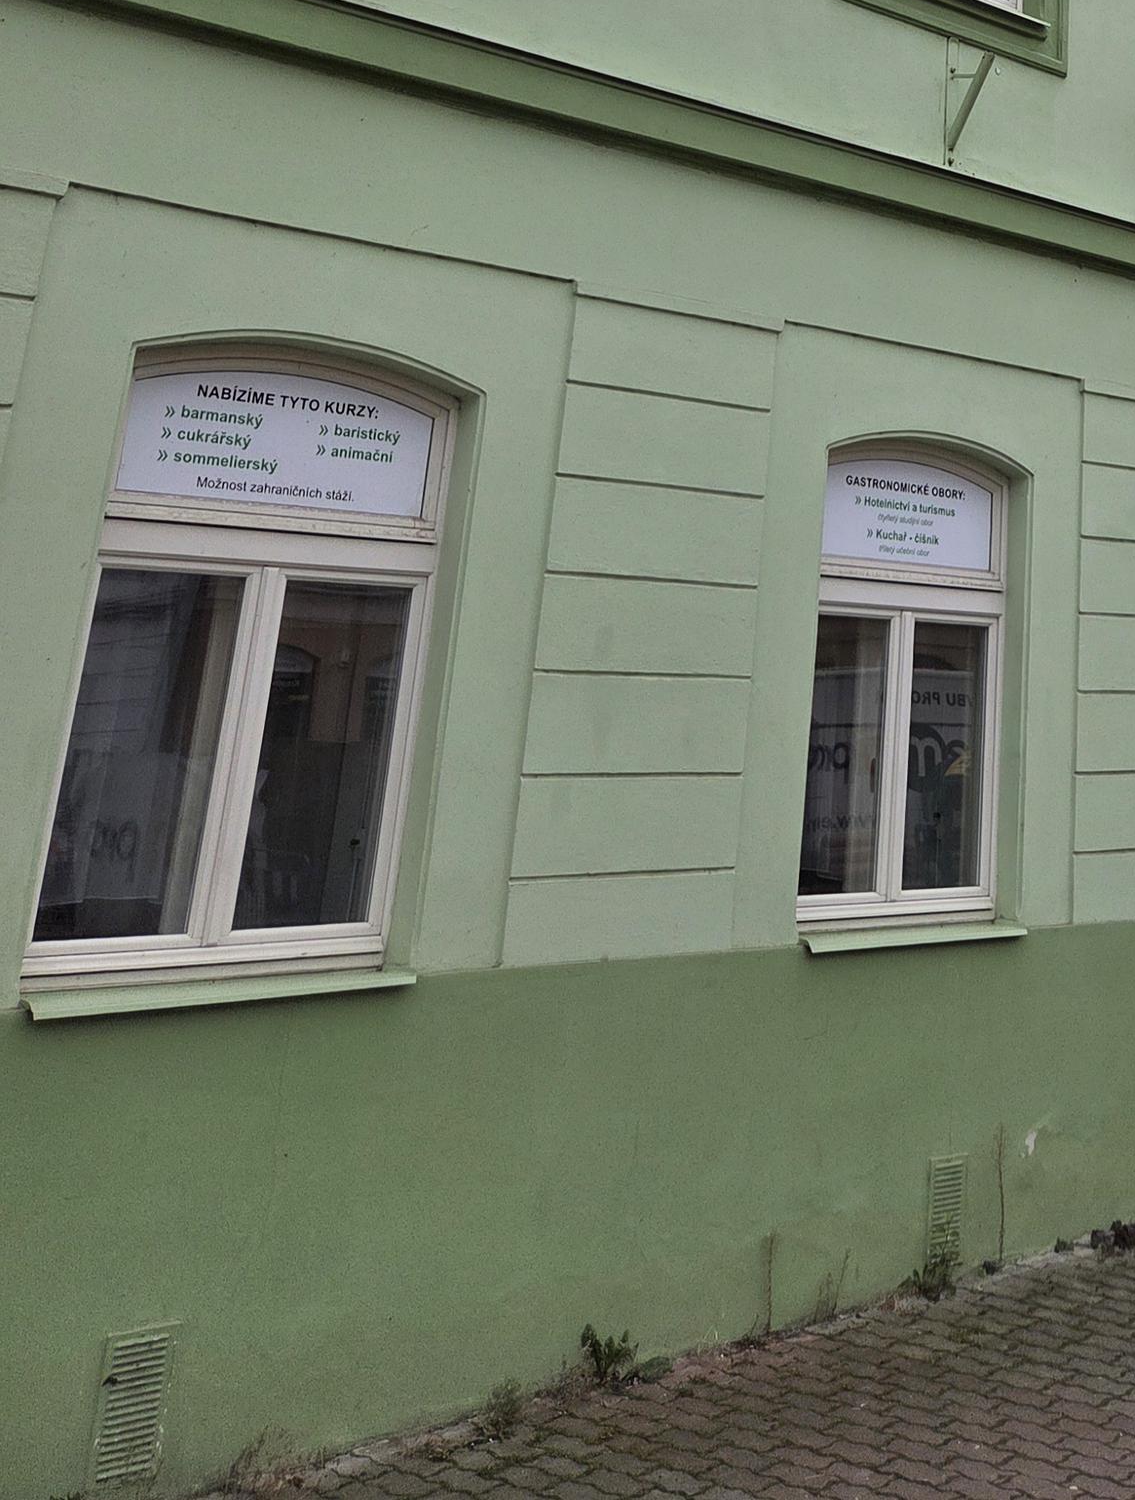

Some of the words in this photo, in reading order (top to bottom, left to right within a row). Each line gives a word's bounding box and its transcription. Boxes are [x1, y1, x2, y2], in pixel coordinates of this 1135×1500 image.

[197, 384, 274, 406] NABÍZÍME
[279, 395, 320, 411] TYTO
[325, 400, 379, 419] KURZY:
[181, 406, 263, 428] barmanský
[177, 428, 251, 450] cukrářský
[334, 425, 401, 445] baristický
[173, 451, 278, 475] sommelierský
[331, 445, 393, 464] animační
[196, 476, 246, 492] Možnost
[250, 481, 322, 499] zahraničních
[326, 488, 354, 502] stáží.
[846, 475, 929, 496] GASTRONOMICKÉ
[932, 486, 966, 500] OBORY:
[864, 496, 910, 512] Hotelnictví
[919, 503, 955, 517] turismus
[876, 528, 907, 542] Kuchař
